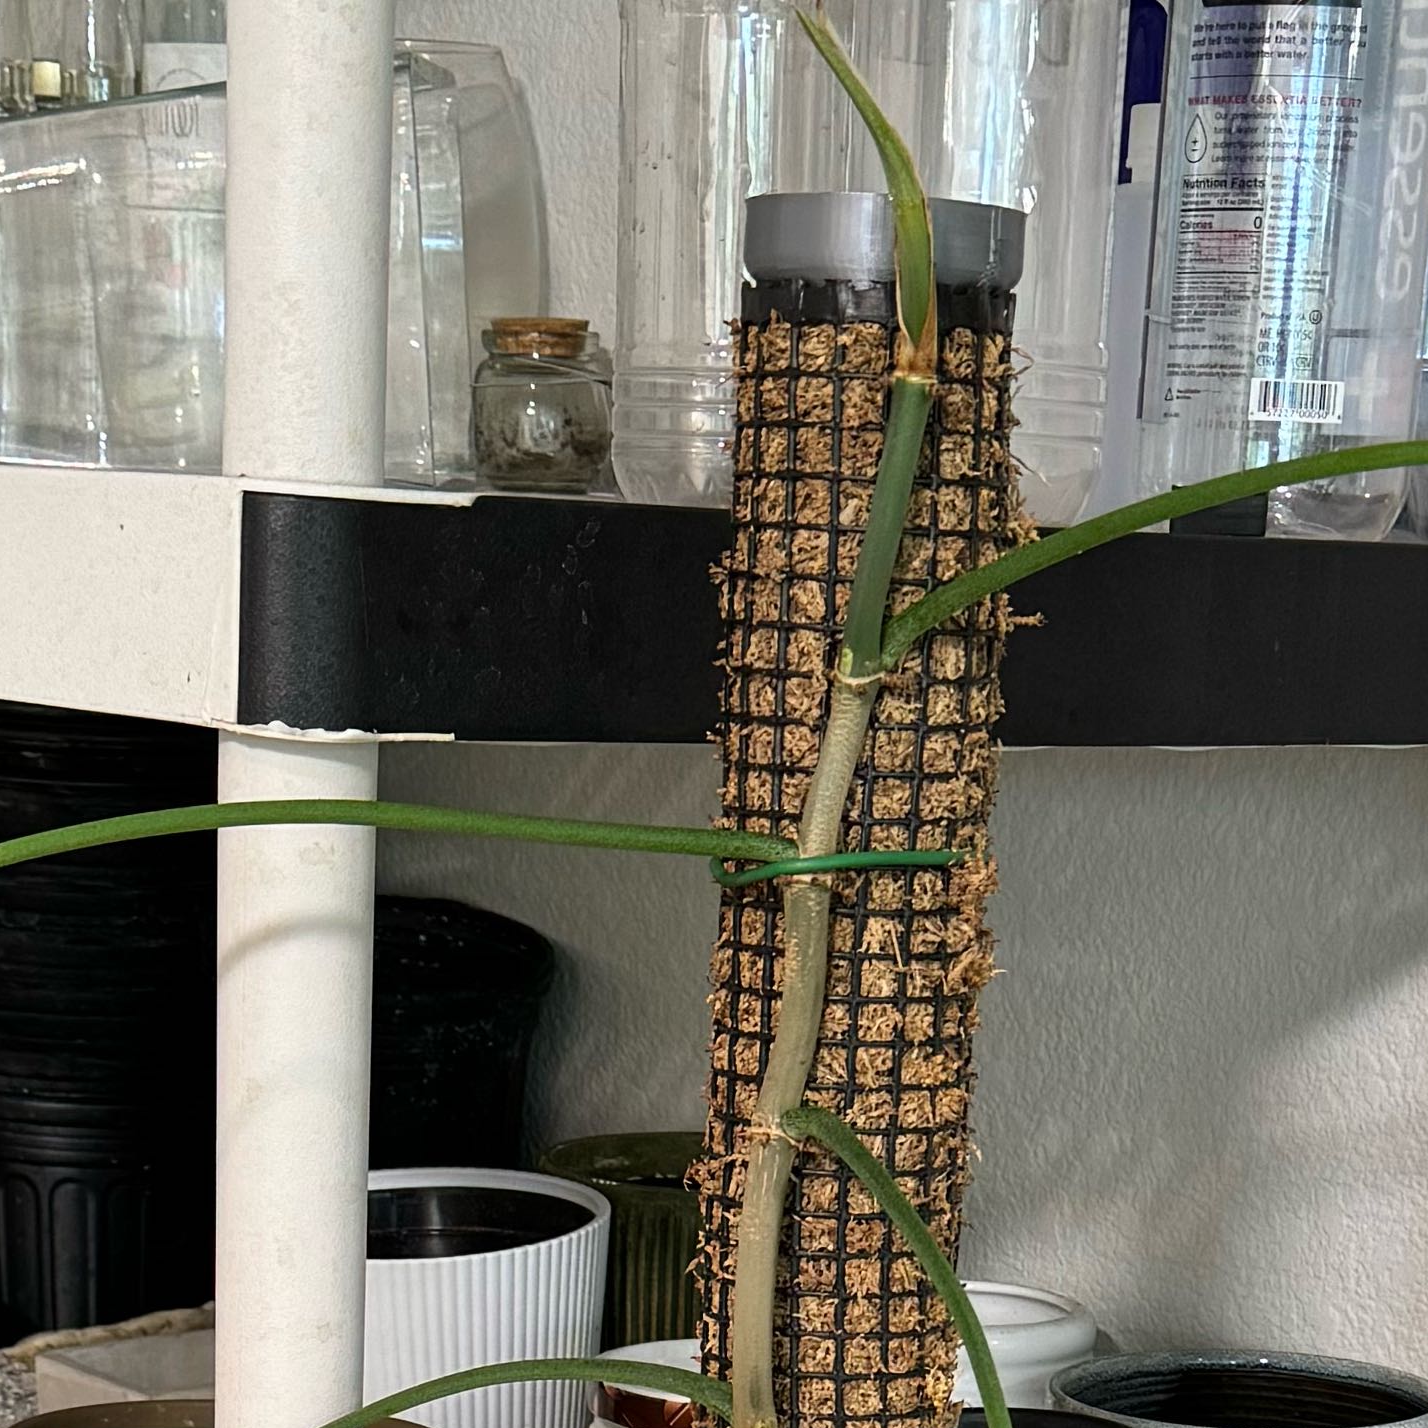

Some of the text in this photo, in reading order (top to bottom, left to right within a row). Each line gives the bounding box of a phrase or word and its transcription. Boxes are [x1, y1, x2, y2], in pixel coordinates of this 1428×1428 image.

[1276, 20, 1296, 33] flag
[1275, 35, 1297, 45] that
[1182, 176, 1266, 190] Nutrition Facts
[1179, 216, 1263, 230] Calories 0
